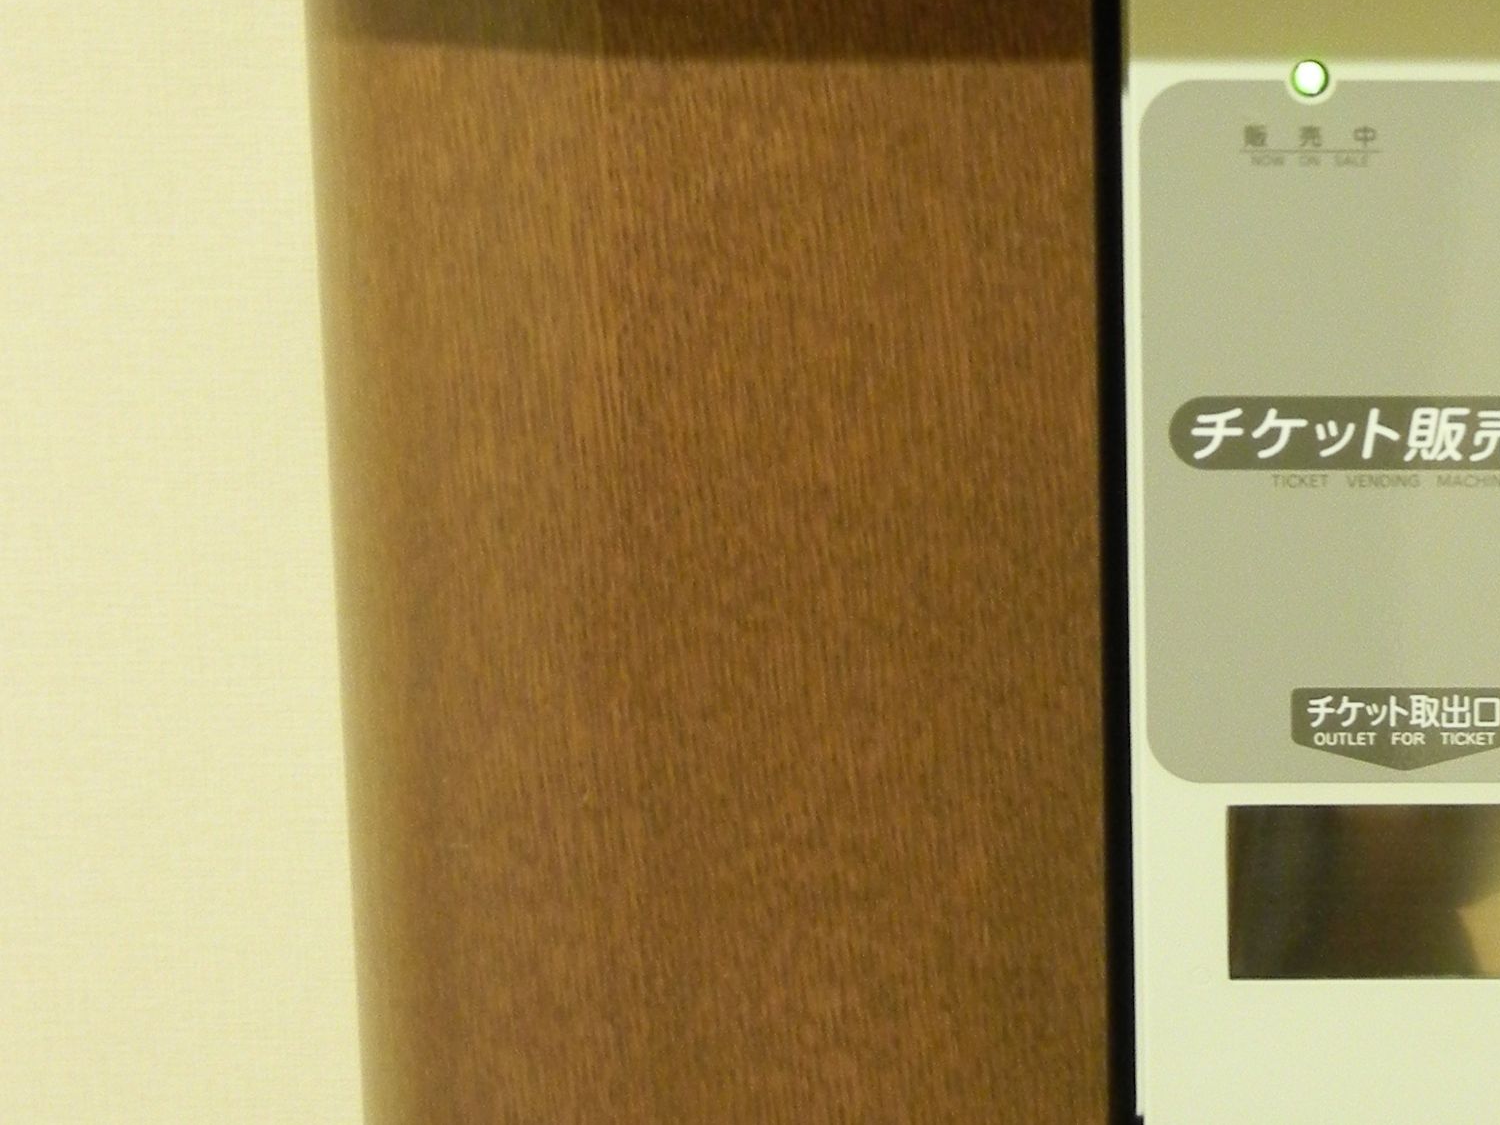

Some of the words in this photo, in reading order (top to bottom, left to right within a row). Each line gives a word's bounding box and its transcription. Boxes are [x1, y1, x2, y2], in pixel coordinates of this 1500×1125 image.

[1273, 474, 1329, 489] TICKET
[1346, 474, 1421, 489] VENDING
[1313, 731, 1377, 746] OUTLET
[1391, 732, 1426, 746] FOR
[1440, 732, 1496, 746] TICKET
